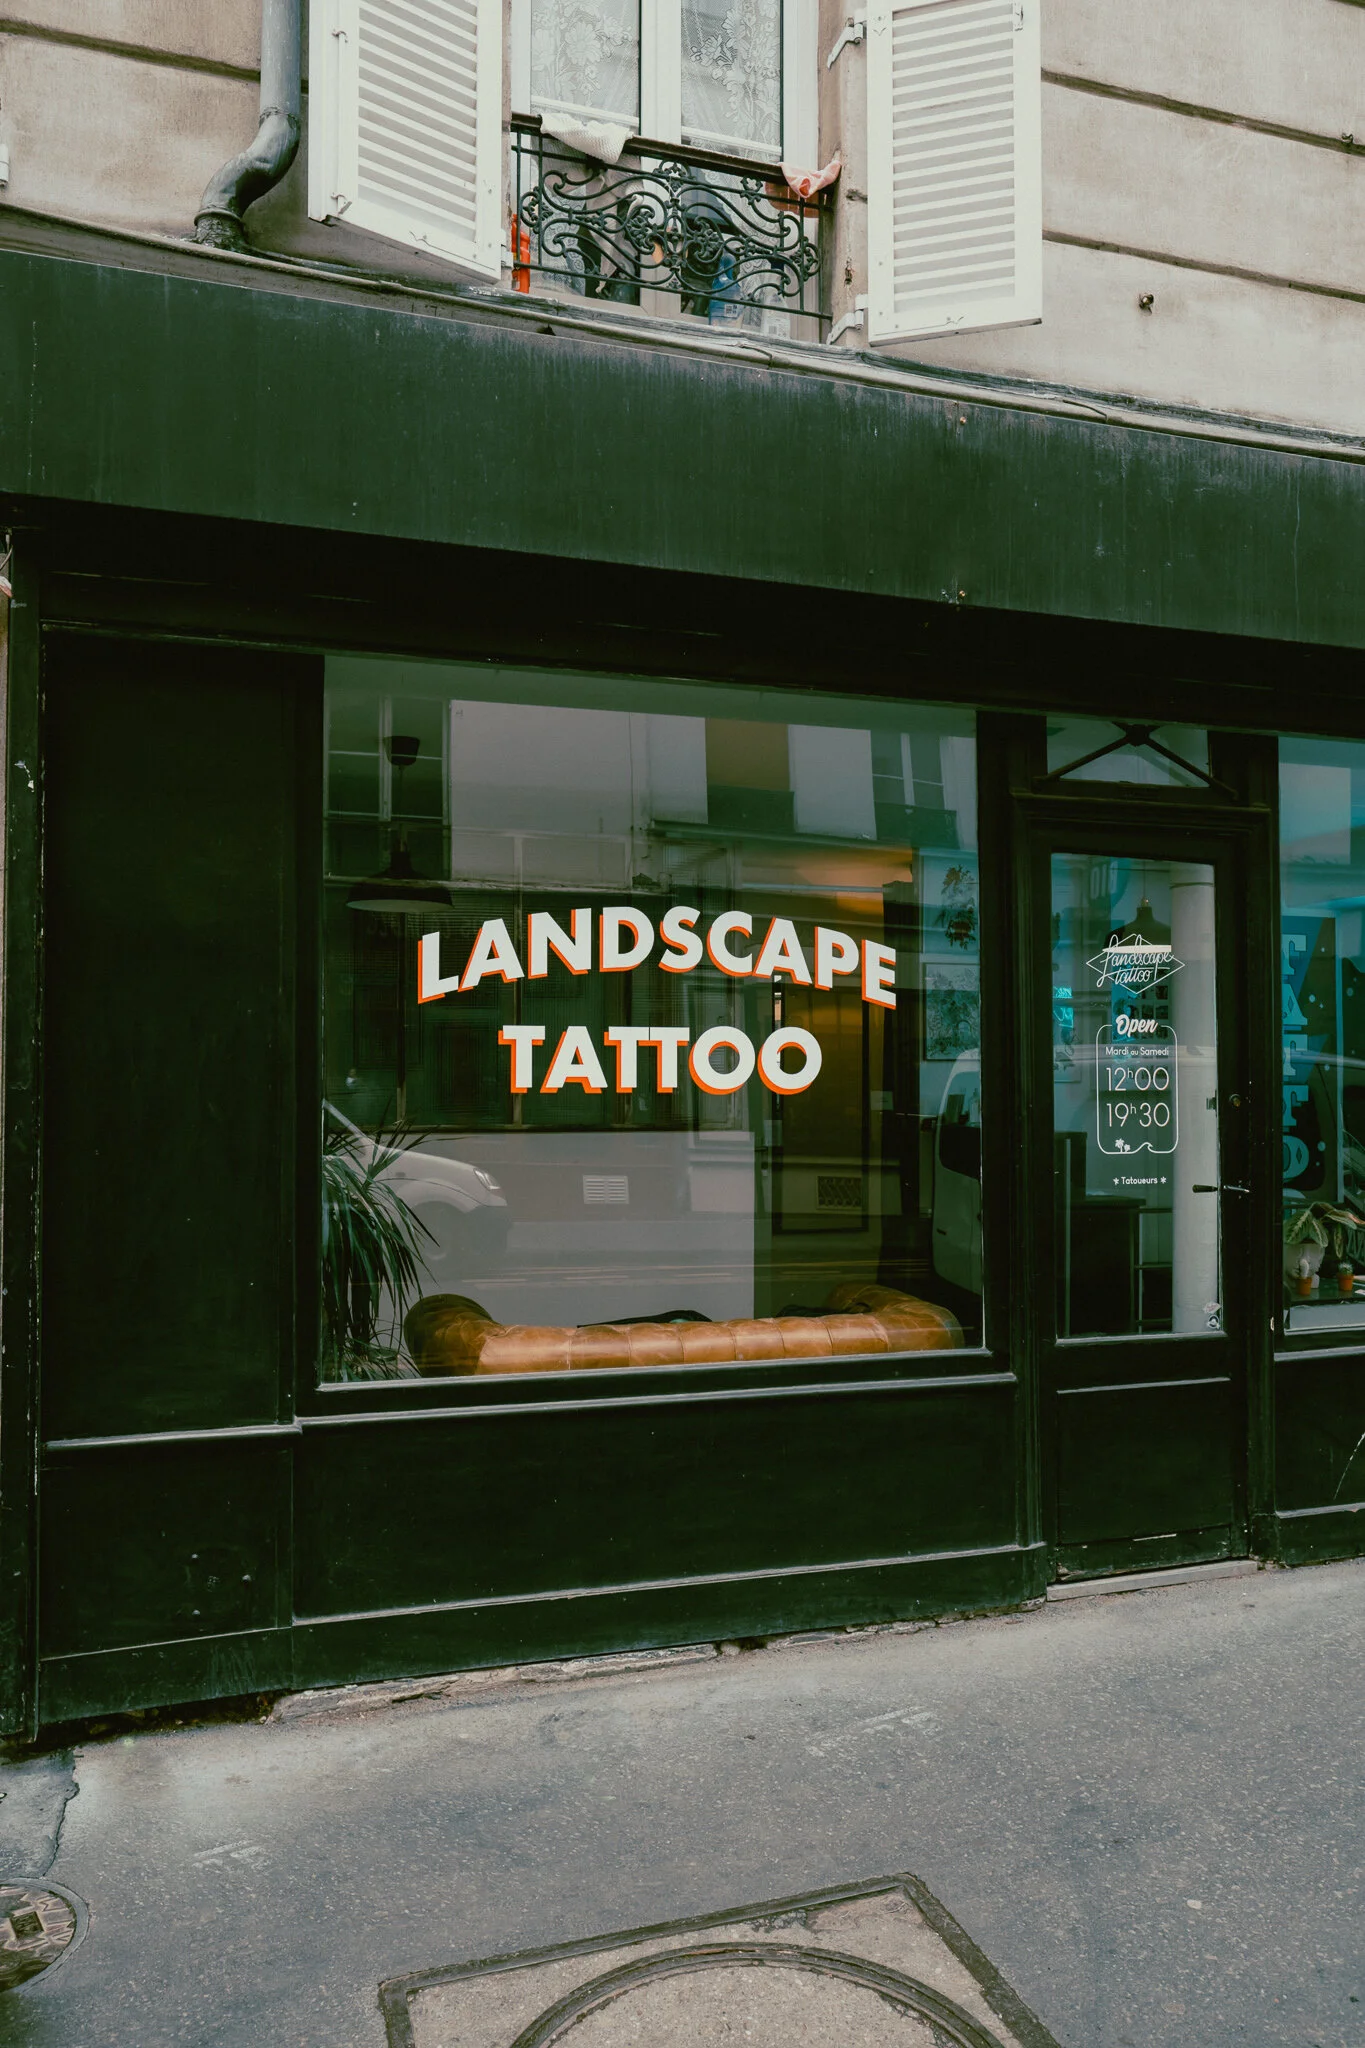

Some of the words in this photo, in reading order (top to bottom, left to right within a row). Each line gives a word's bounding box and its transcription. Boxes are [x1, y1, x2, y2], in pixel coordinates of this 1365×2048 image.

[418, 906, 897, 1010] LANDSCAPE
[1096, 934, 1174, 987] Landscape
[1114, 967, 1154, 985] tattoo
[1115, 1013, 1158, 1038] Open
[498, 1025, 823, 1095] TATTOO
[1105, 1046, 1129, 1056] Mardi
[1140, 1046, 1169, 1056] Samedi
[1105, 1066, 1170, 1092] 12h00
[1106, 1102, 1170, 1128] 19h30
[1120, 1176, 1158, 1185] Tatoueurs
